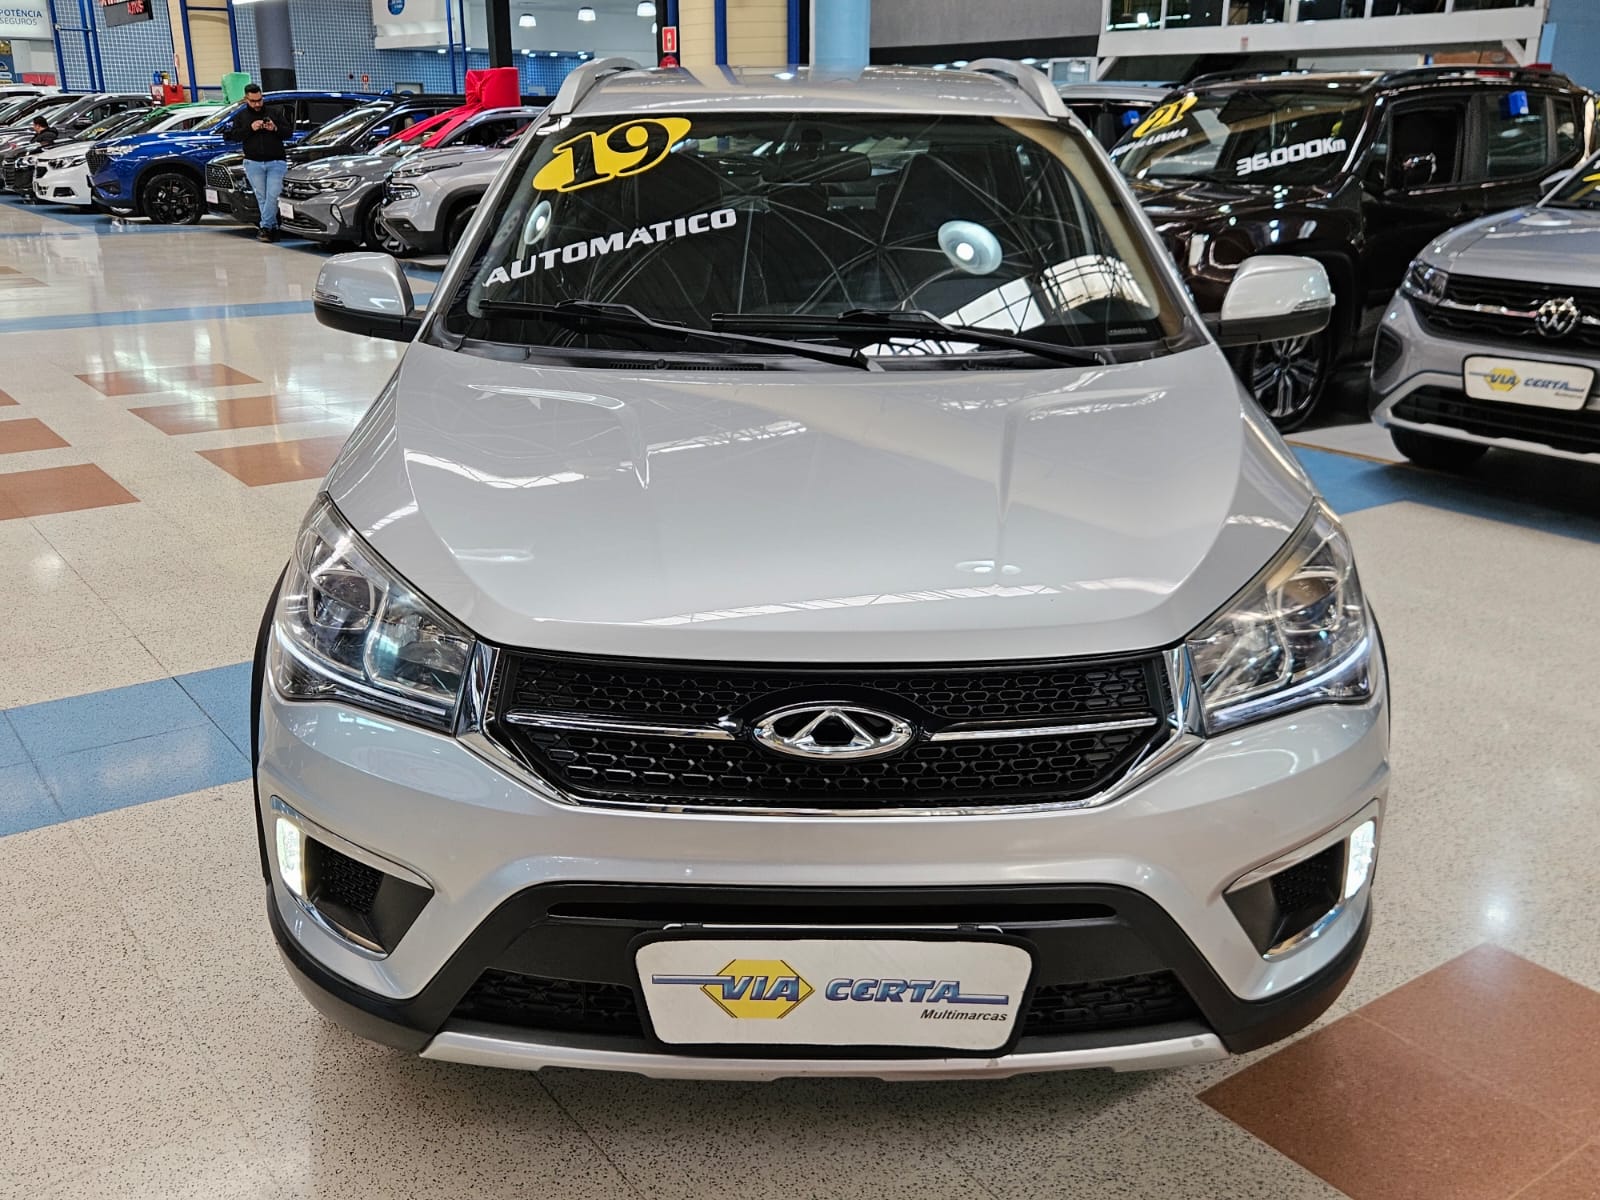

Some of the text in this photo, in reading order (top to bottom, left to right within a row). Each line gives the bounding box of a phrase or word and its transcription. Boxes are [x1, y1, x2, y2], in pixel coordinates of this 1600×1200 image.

[555, 120, 672, 191] 19
[1236, 138, 1347, 176] 36.000Km
[1489, 374, 1517, 385] VIA
[720, 975, 960, 1003] VIA CERTA
[920, 1008, 1008, 1022] Multimarcas
